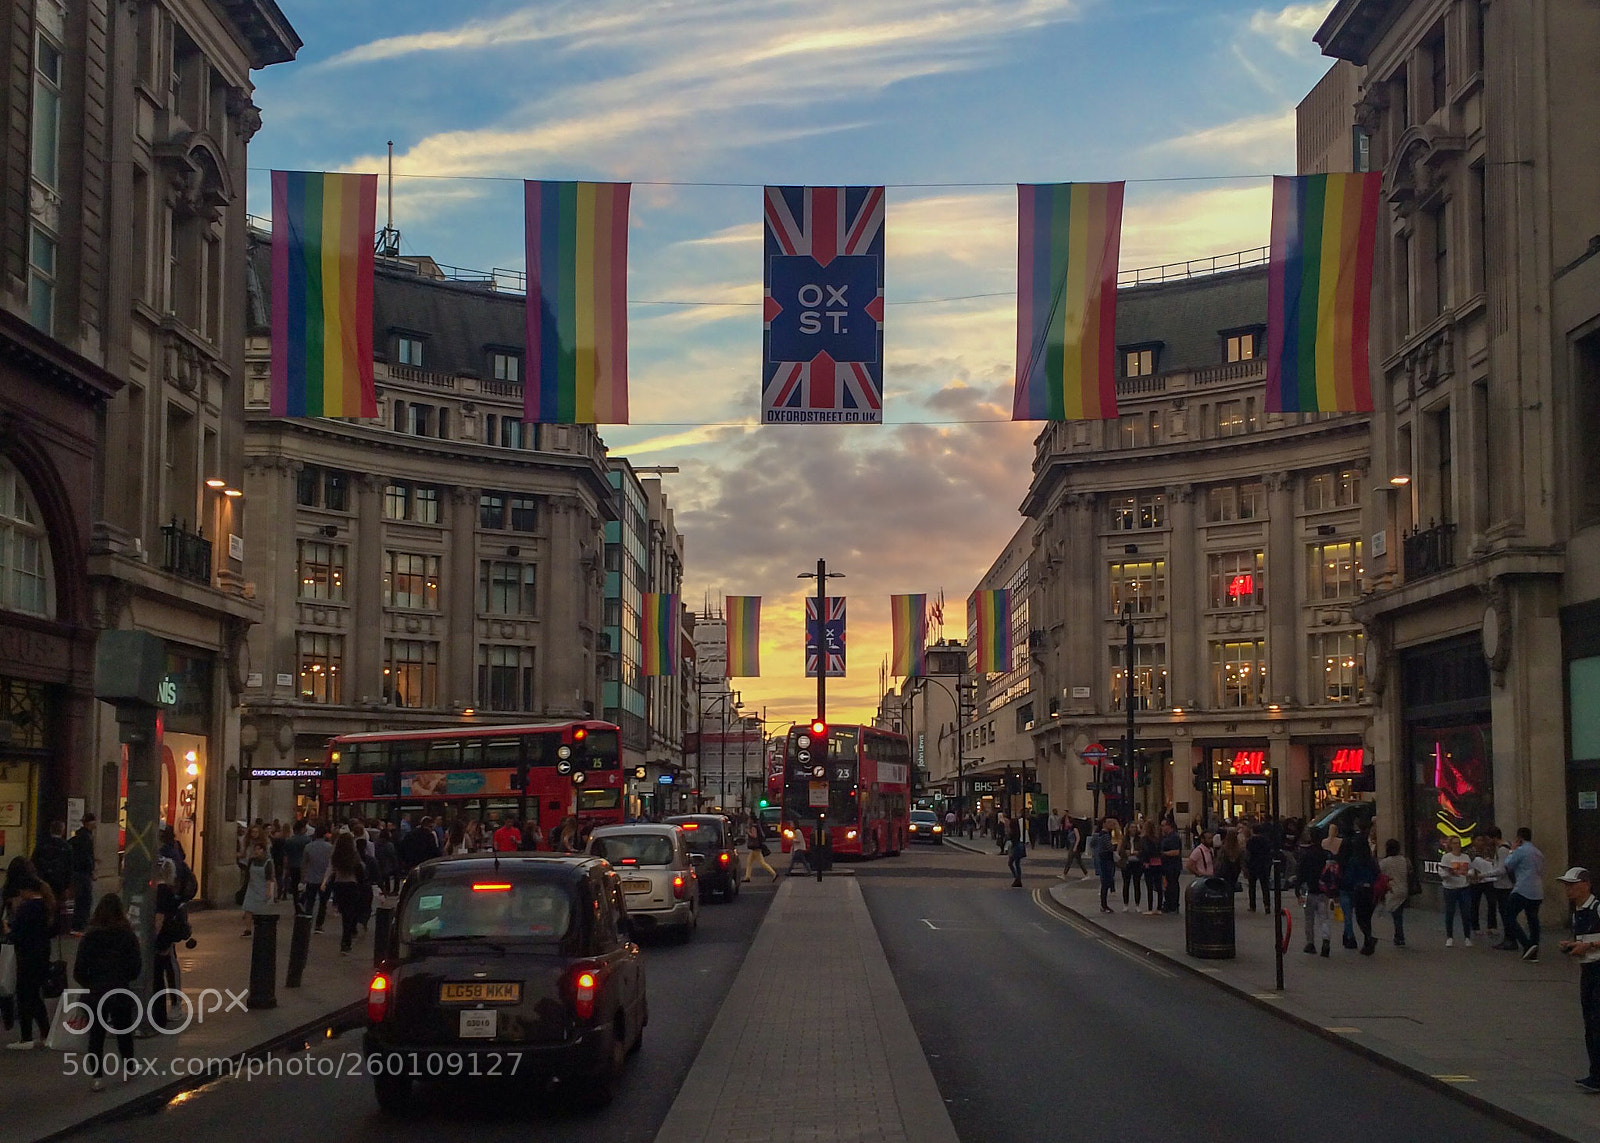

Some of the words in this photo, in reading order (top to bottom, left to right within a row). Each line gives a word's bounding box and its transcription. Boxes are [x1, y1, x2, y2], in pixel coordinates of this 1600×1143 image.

[798, 284, 848, 307] OX
[799, 311, 848, 335] ST.
[767, 410, 876, 422] OXFORDSTREET.CO.UK
[917, 734, 925, 752] Lewis
[917, 752, 926, 767] John
[1232, 751, 1264, 775] H&M
[1331, 748, 1364, 773] H&M
[636, 767, 645, 778] 3
[837, 768, 850, 779] 23
[974, 782, 993, 792] BHS
[1424, 860, 1440, 874] NIK
[446, 984, 482, 998] LG58
